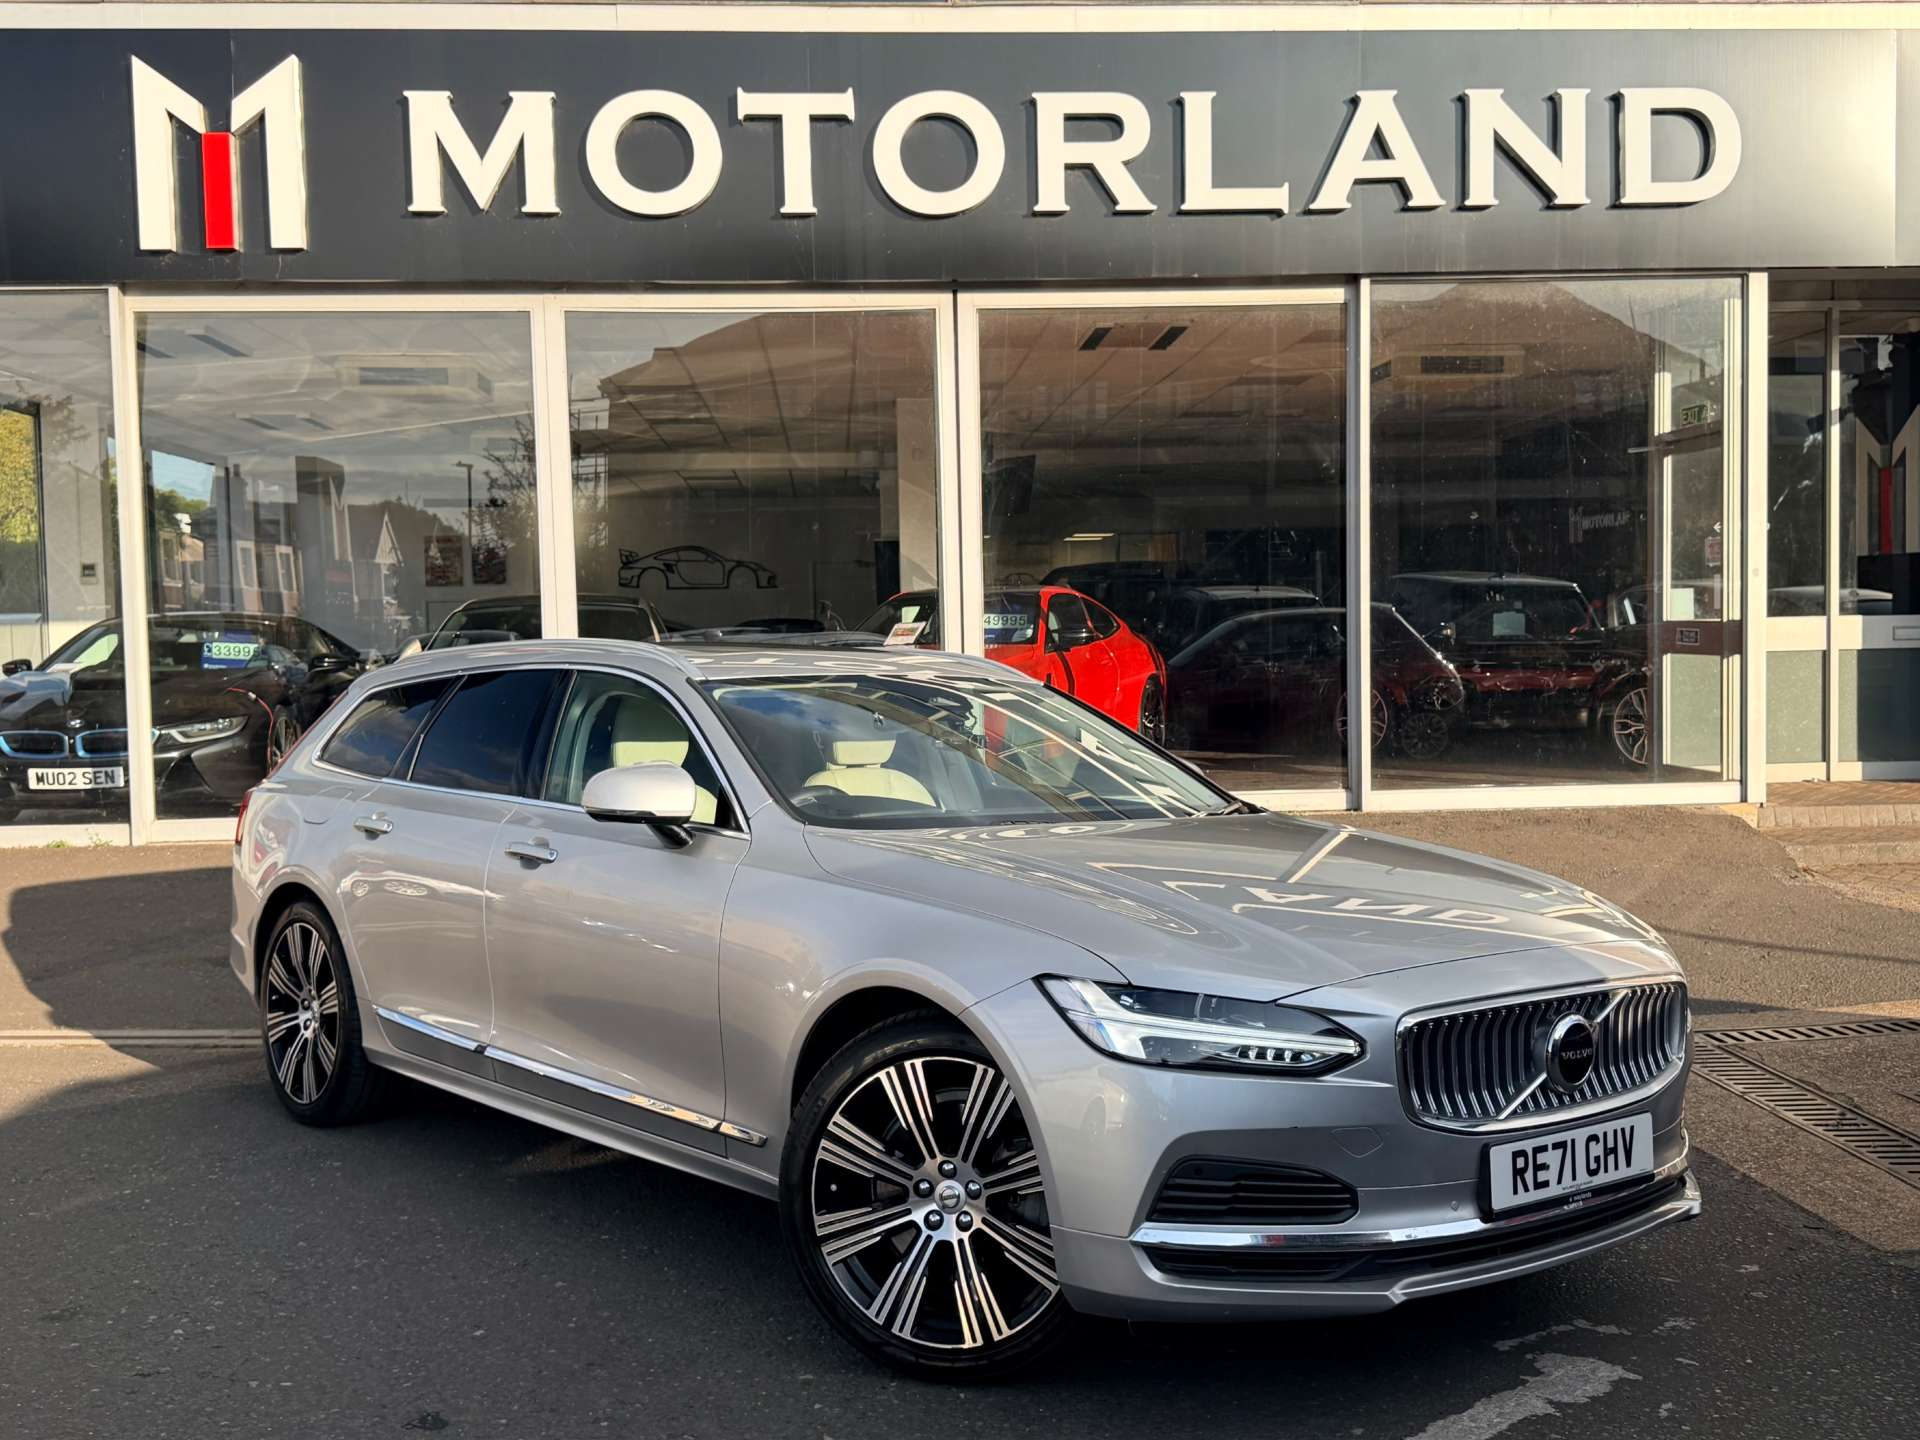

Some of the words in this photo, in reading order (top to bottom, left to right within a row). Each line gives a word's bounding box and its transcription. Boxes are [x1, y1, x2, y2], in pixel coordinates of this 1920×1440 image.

[403, 88, 1743, 218] MOTORLAND
[984, 615, 1026, 626] 49995
[35, 771, 77, 786] MU02
[82, 769, 115, 785] SEN
[1560, 1047, 1593, 1060] VOLVO
[1511, 1137, 1577, 1196] RE71
[1584, 1125, 1635, 1178] GHV
